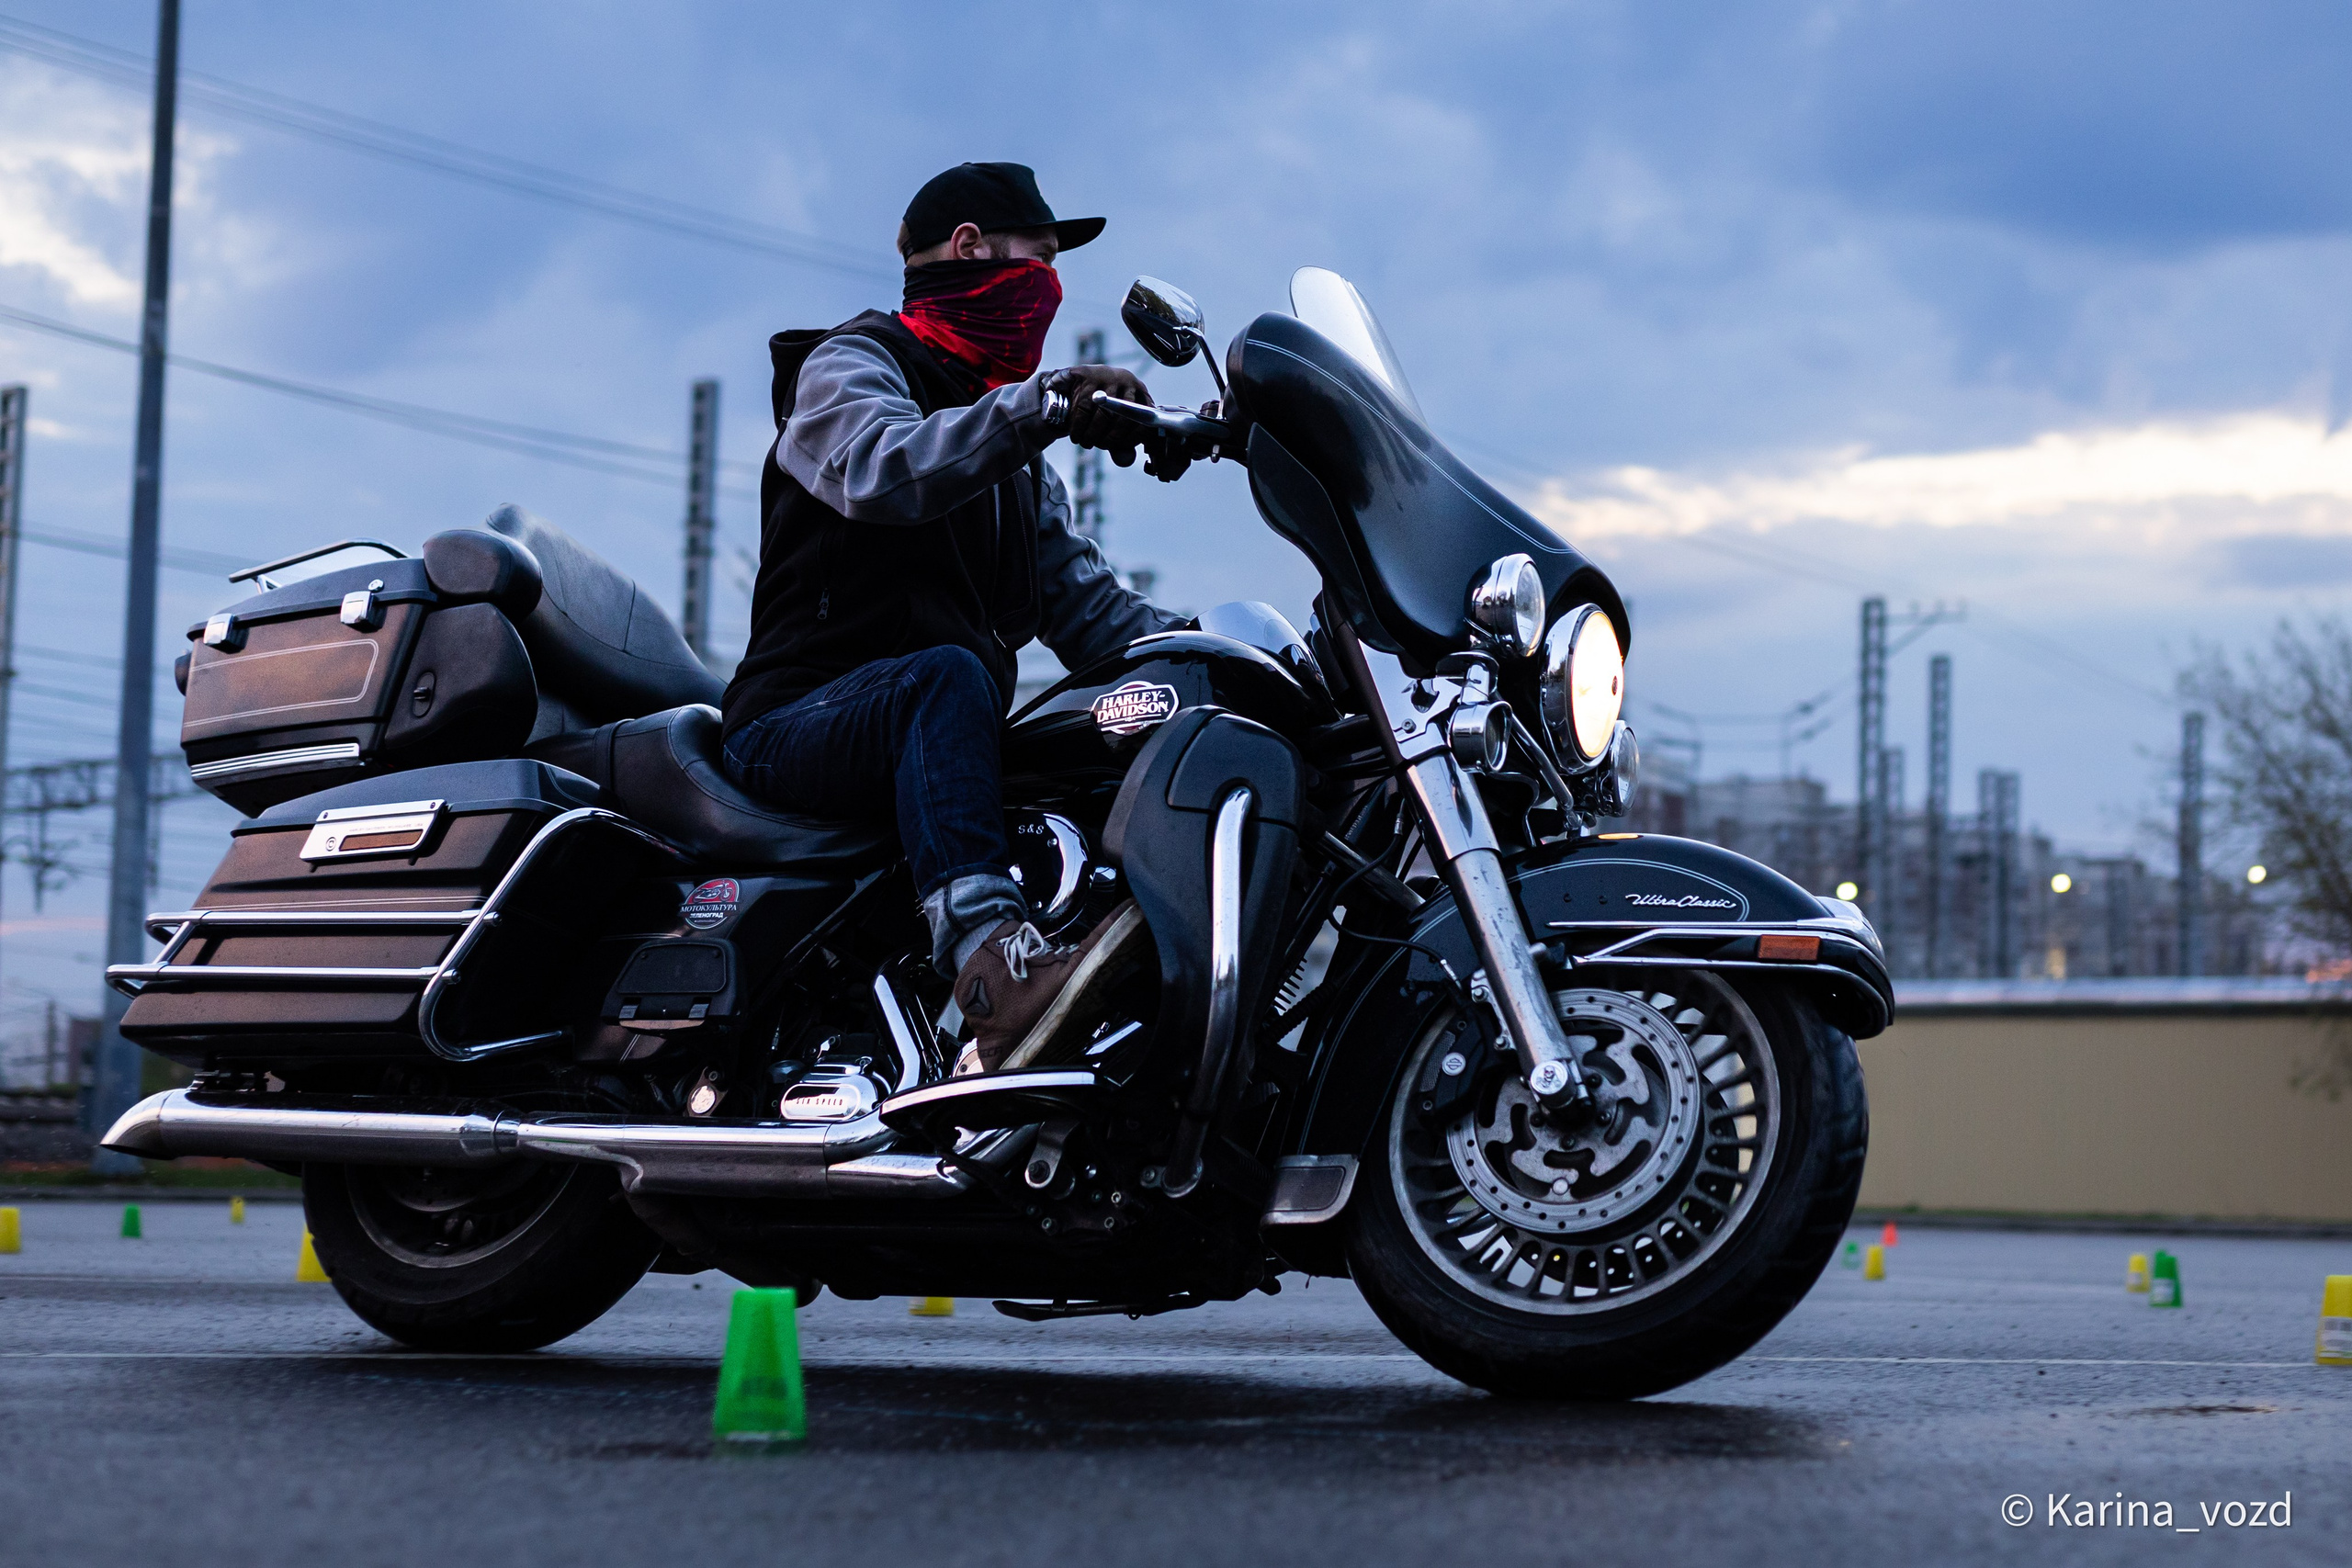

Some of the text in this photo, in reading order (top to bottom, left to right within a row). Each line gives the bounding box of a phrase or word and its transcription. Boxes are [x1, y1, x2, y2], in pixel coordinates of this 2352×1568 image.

[1102, 691, 1166, 710] HARLEY-
[1097, 701, 1169, 723] DAVIDSON
[680, 904, 737, 913] МОТОКУЛЬТУРА
[816, 1098, 843, 1106] SPEED
